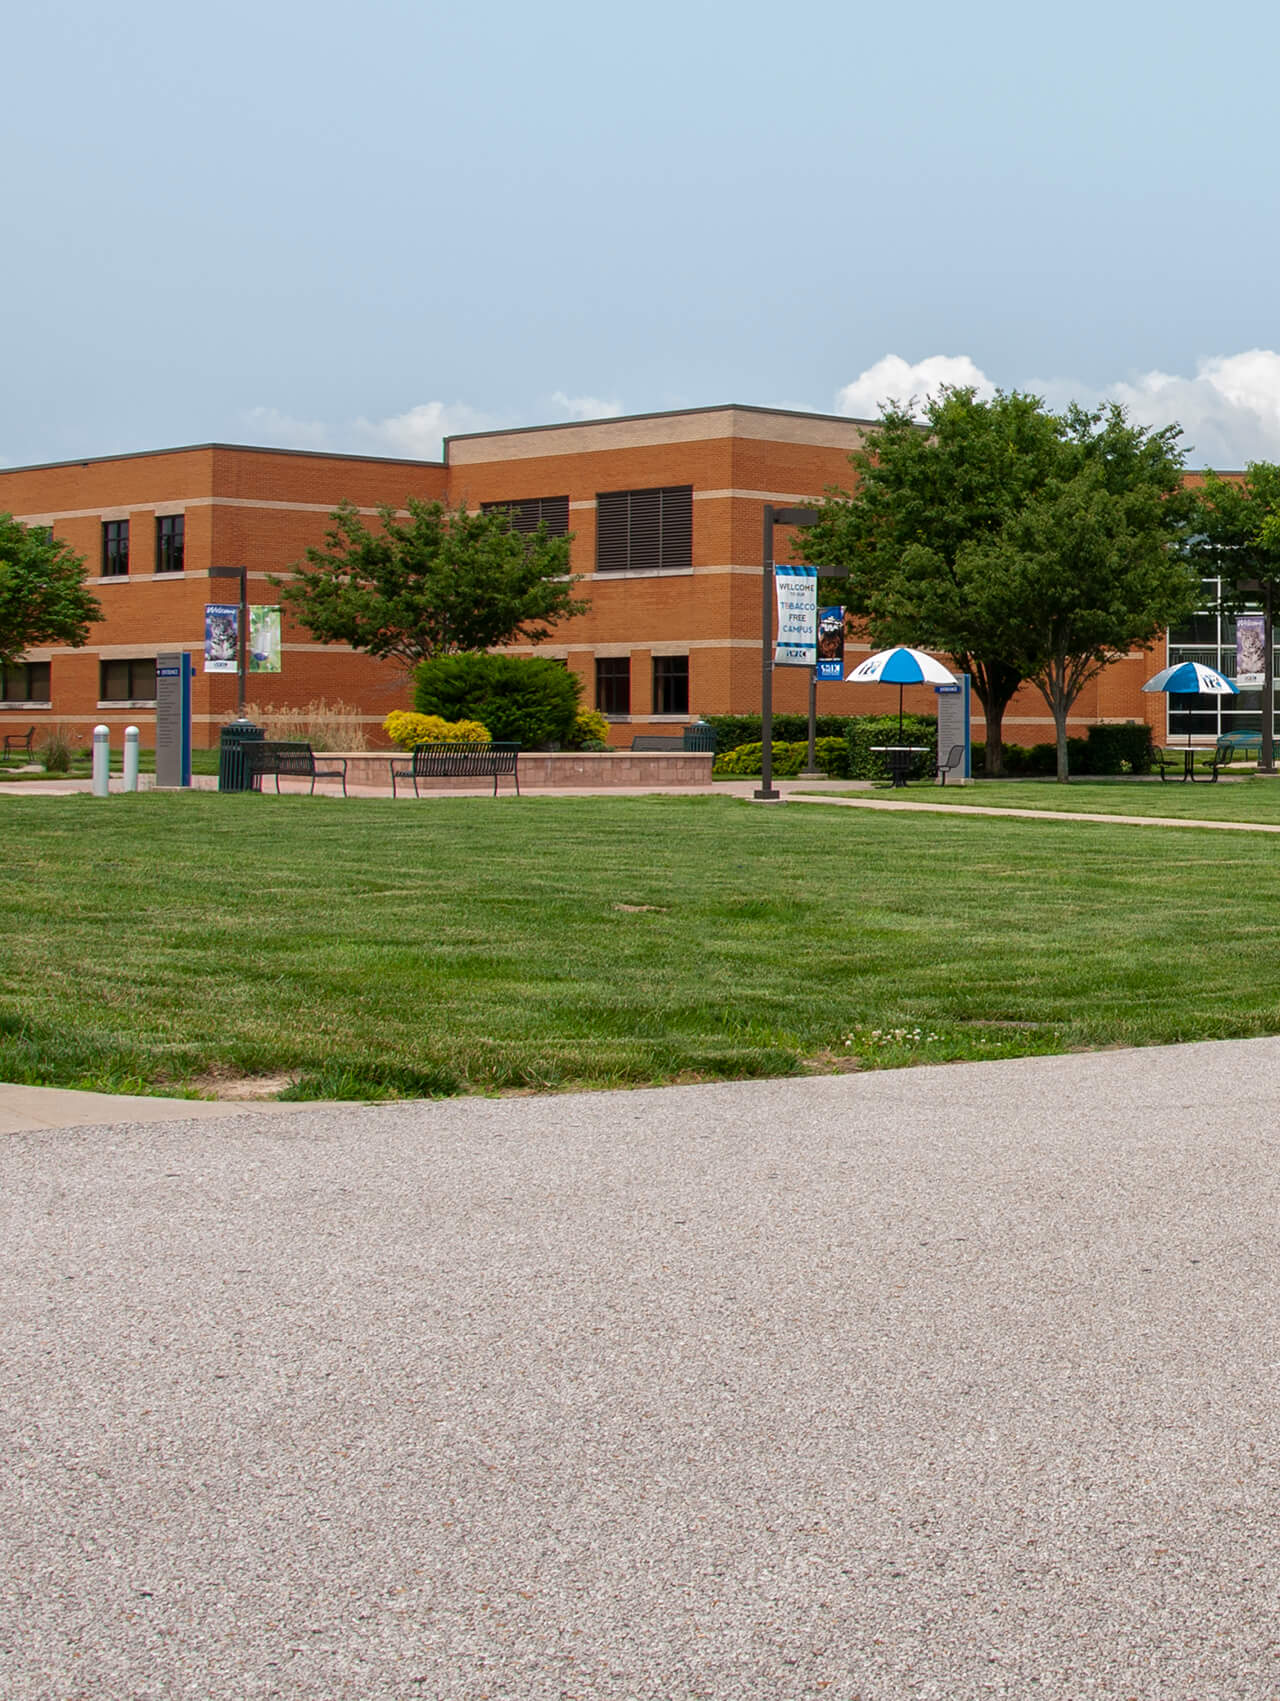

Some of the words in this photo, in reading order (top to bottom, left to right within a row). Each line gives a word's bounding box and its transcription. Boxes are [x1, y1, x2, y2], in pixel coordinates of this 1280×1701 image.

[780, 583, 815, 592] WELCOME
[780, 601, 816, 611] TOBACCO
[789, 614, 807, 622] FREE
[783, 625, 813, 633] CAMPUS
